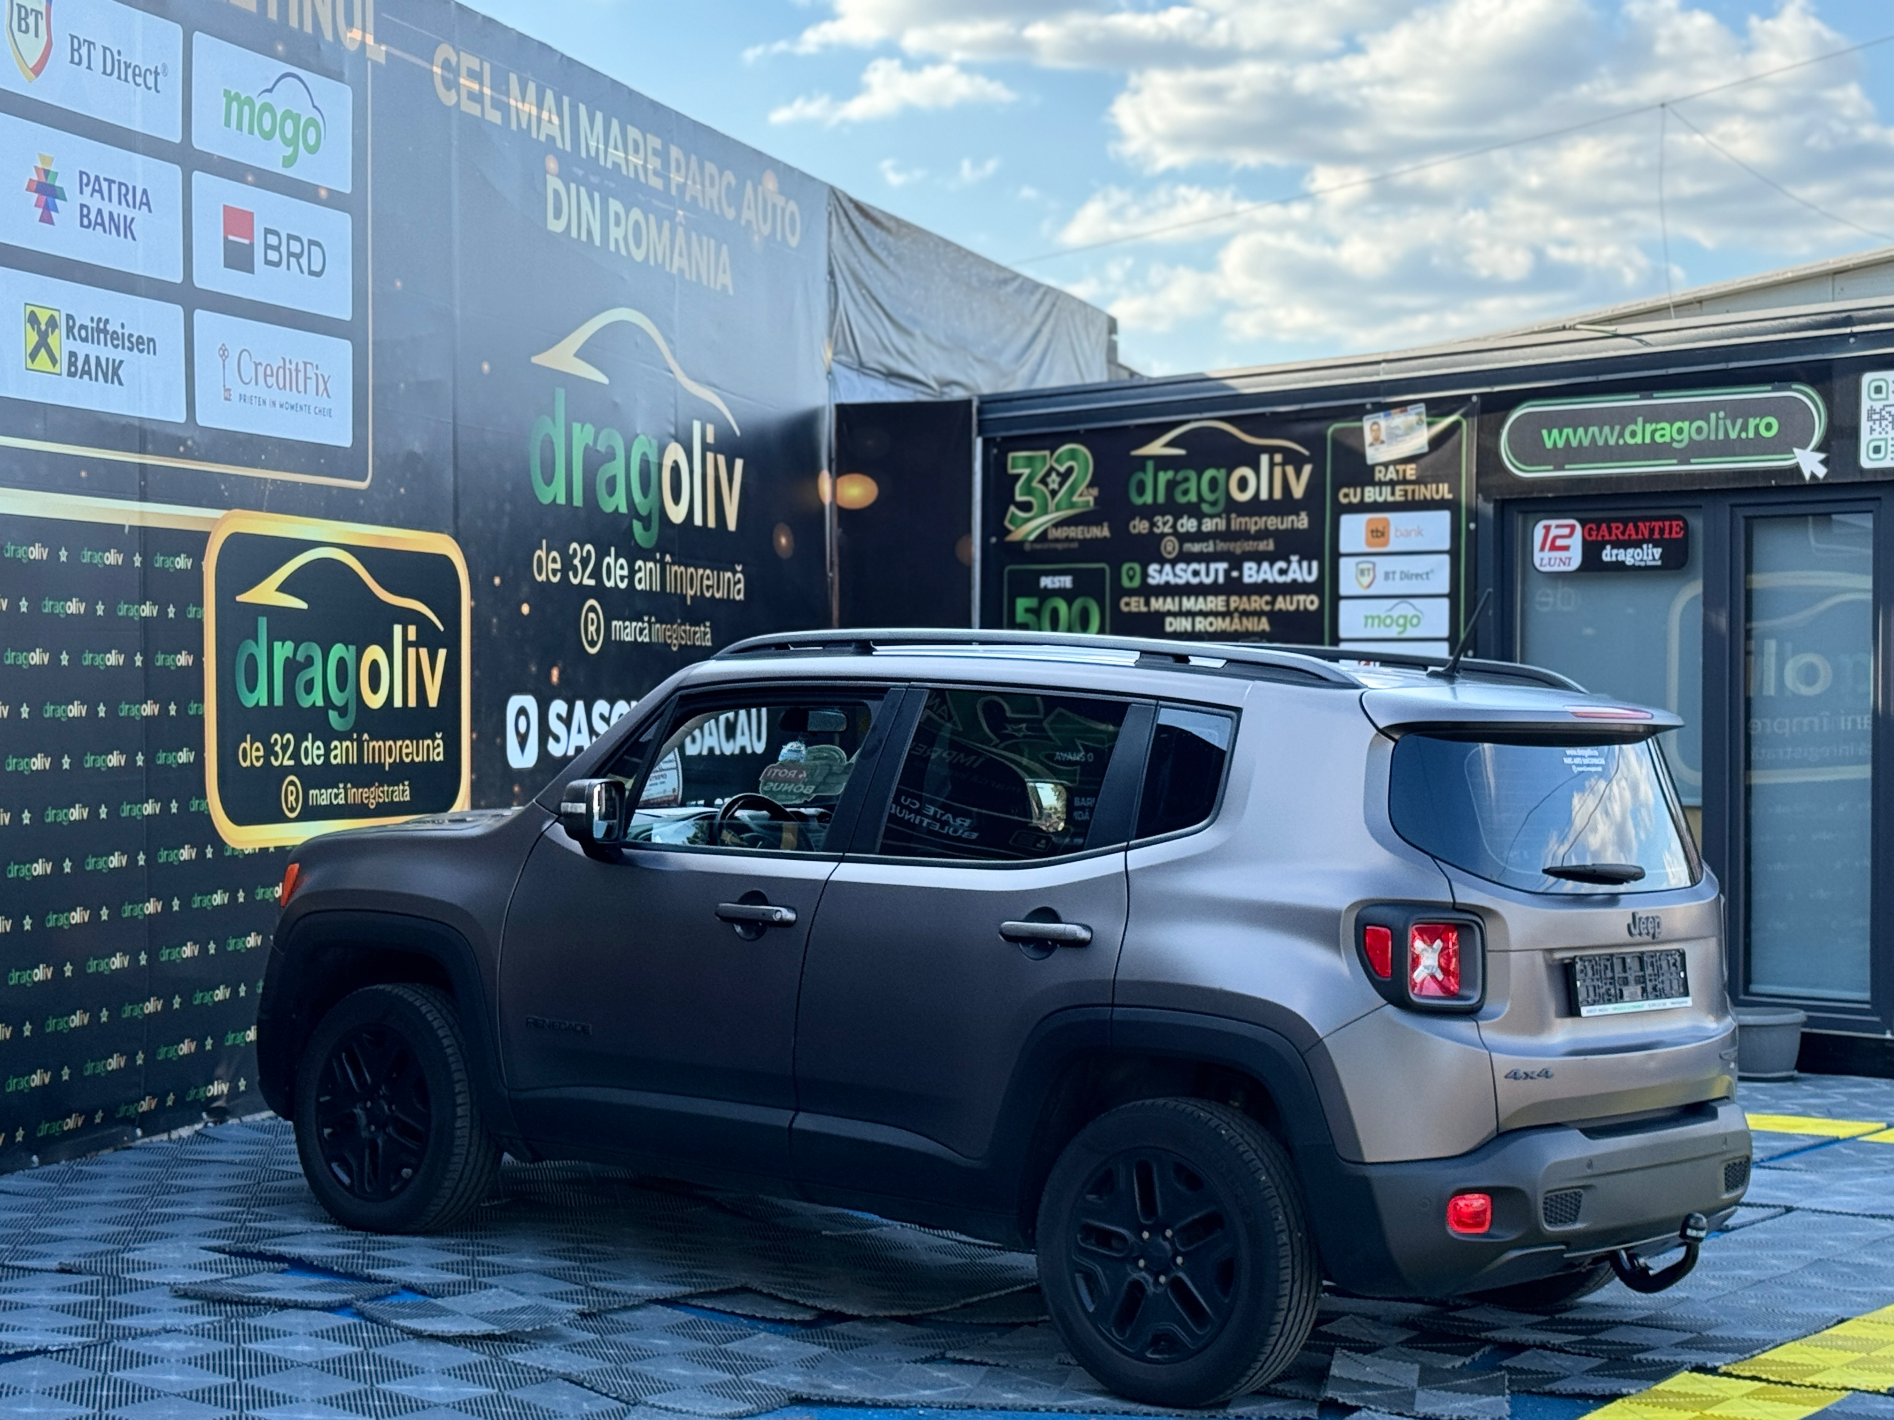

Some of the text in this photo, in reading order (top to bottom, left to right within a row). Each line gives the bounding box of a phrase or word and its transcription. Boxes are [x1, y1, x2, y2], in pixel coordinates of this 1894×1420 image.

[16, 2, 43, 39] BT
[68, 33, 96, 71] BT
[222, 87, 323, 169] mogo
[432, 43, 801, 249] CEL MAI MARE PARC AUTO
[78, 169, 153, 214] PATRIA
[78, 203, 138, 242] BANK
[546, 172, 734, 296] DIN ROMÂNIA
[263, 226, 327, 278] BRD
[65, 313, 157, 356] Raiffeisen
[66, 350, 125, 387] BANK
[236, 348, 331, 399] CreditFix
[278, 400, 312, 415] MOMENTE
[1541, 411, 1779, 449] www.dragoliv.ro
[530, 387, 744, 549] dragoliv
[1128, 453, 1313, 515] dragoliv
[1374, 463, 1417, 482] RATE
[1003, 442, 1095, 535] 32
[1338, 483, 1453, 504] CU BULETINUL
[1129, 511, 1309, 535] de 32 de ani împreună
[1371, 525, 1424, 539] tbi bank
[1538, 520, 1685, 553] 12 GARANTIE
[4, 541, 193, 572] dragoliv dragoliv dragoliv
[532, 539, 746, 605] de 32 de ani împreună
[1147, 562, 1229, 585] SASCUT
[1242, 555, 1319, 583] BACĂU
[1539, 543, 1663, 568] LUNI dragoliv
[1039, 575, 1073, 590] PESTE
[1383, 571, 1397, 582] BT
[41, 597, 159, 620] dragoliv dragoliv
[1013, 597, 1100, 635] 500
[1119, 594, 1319, 613] CEL MAI MARE PARC AUTO
[611, 616, 650, 642] marcă
[651, 617, 713, 651] înregistrată
[1164, 615, 1271, 633] DIN ROMÂNIA
[1364, 612, 1422, 635] mogo
[4, 648, 194, 670] dragoliv dragoliv dragoliv
[235, 616, 447, 732] dragoliv
[42, 699, 160, 720] dragoliv dragoliv
[5, 747, 195, 775] dragoliv dragoliv dragoliv
[238, 732, 444, 772] de 32 de ani împreună
[44, 803, 89, 826] dragoliv
[119, 798, 161, 820] dragoliv
[308, 783, 345, 806] marcă
[347, 780, 411, 809] înregistrată
[6, 858, 52, 881] dragoliv
[84, 851, 128, 873] dragoliv
[157, 844, 197, 865] dragoliv
[45, 882, 283, 929] dragoliv dragoliv dragoliv dragol
[1627, 912, 1663, 939] Jeep
[8, 931, 262, 987] dragoliv dragoliv dragoliv dragoliv
[44, 1010, 90, 1033] dragoliv
[121, 996, 163, 1019] dragoliv
[192, 985, 231, 1006] dragoliv
[224, 1025, 257, 1047] dragoli
[1504, 1067, 1555, 1081] 4x4
